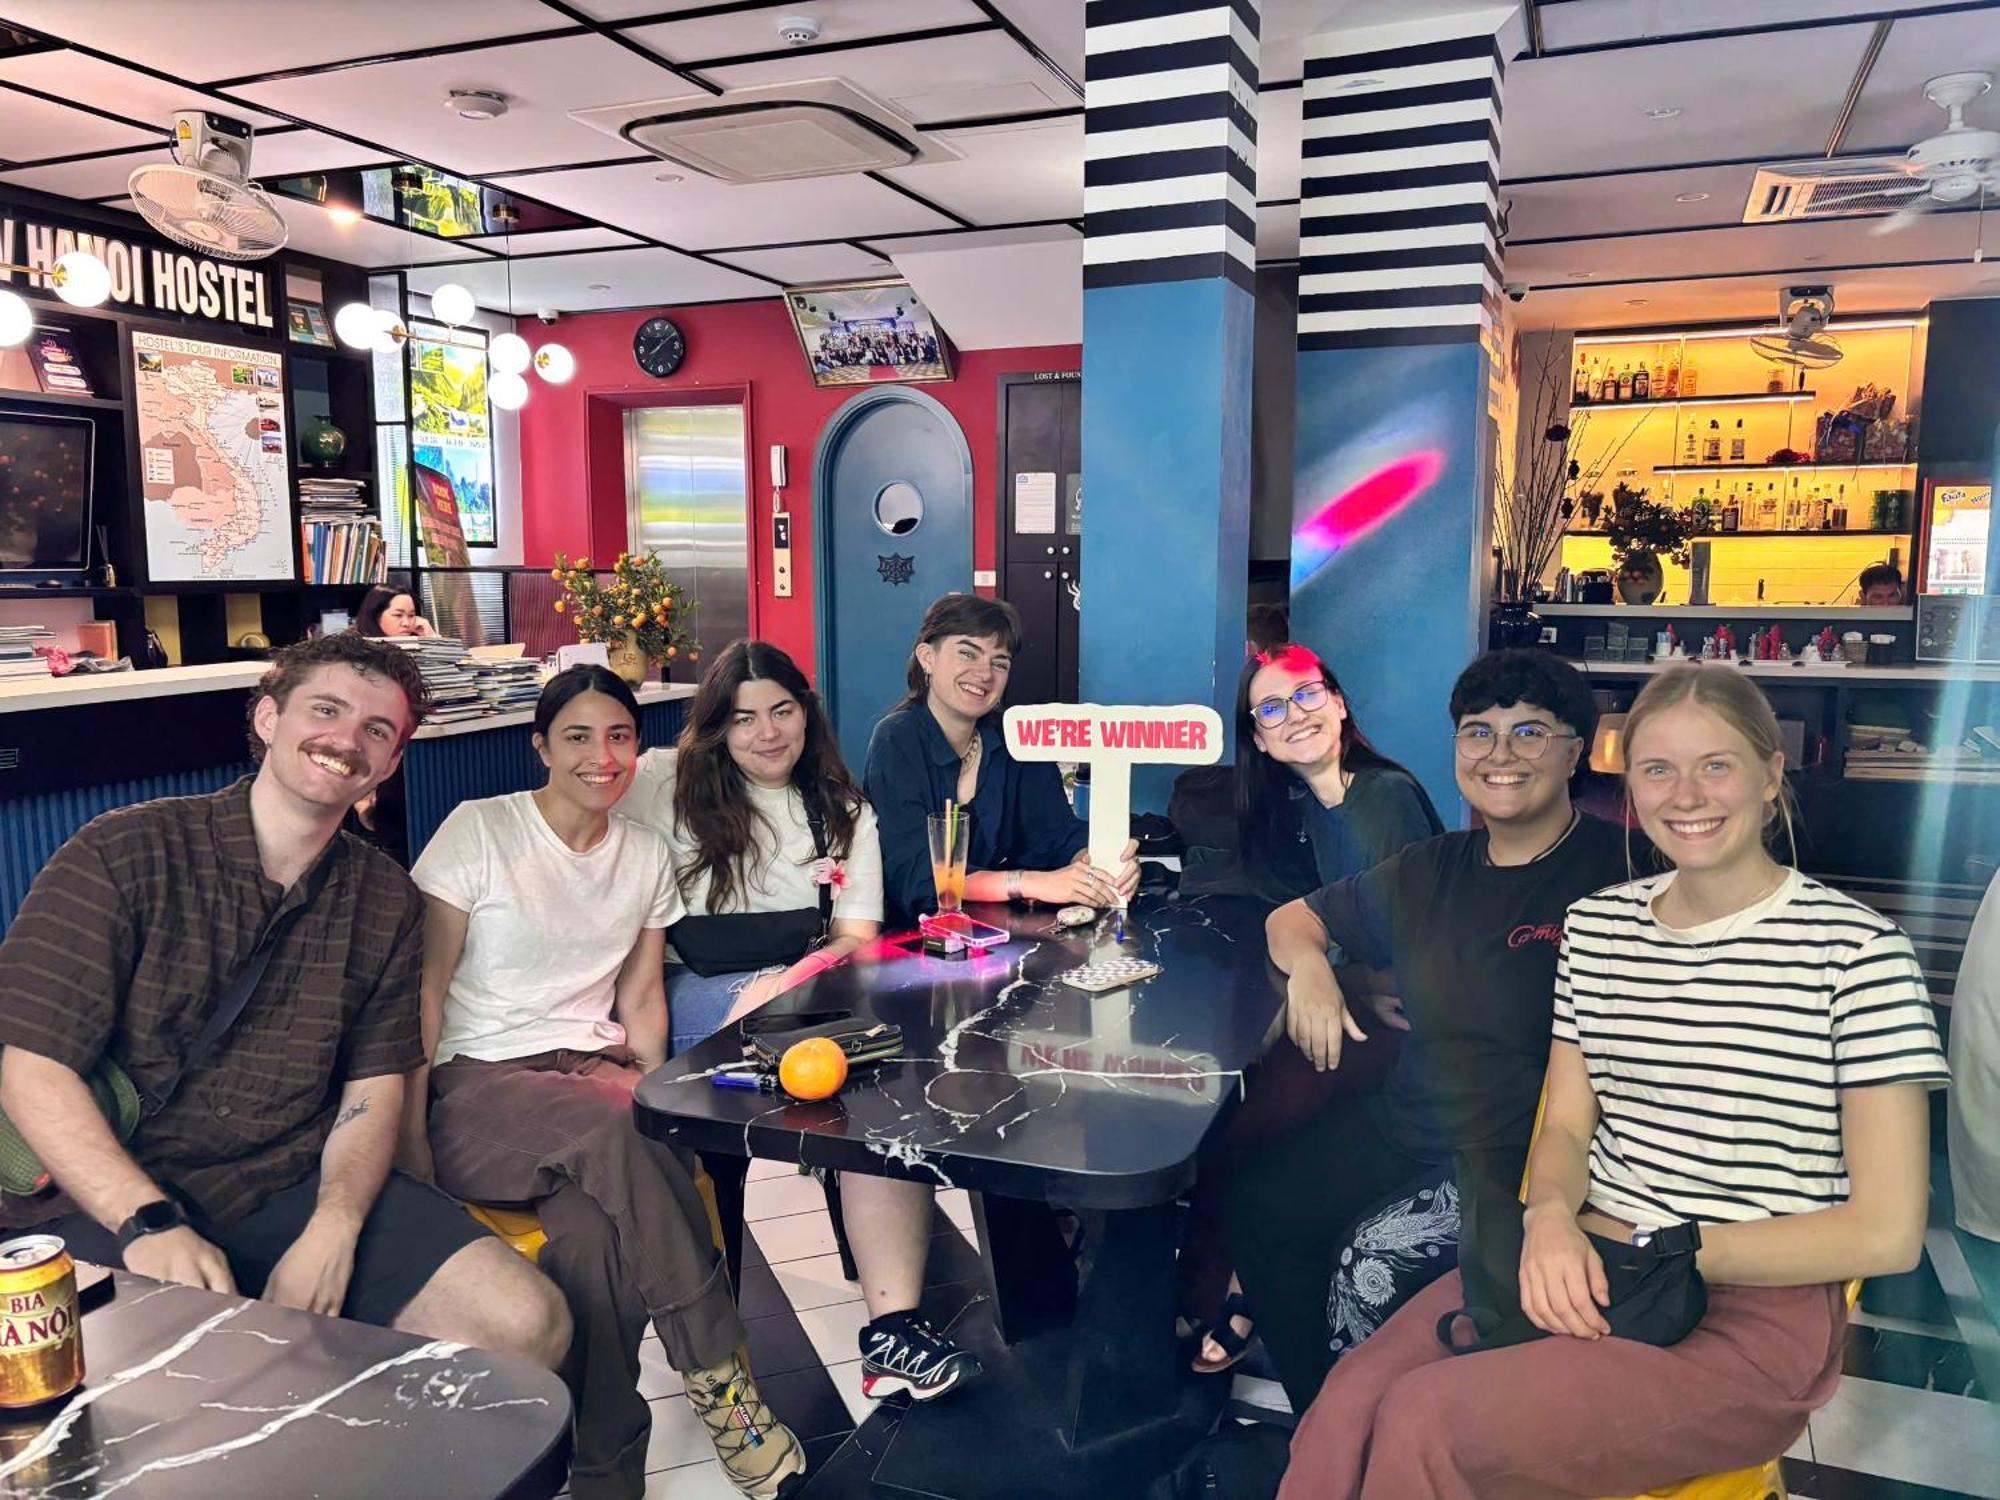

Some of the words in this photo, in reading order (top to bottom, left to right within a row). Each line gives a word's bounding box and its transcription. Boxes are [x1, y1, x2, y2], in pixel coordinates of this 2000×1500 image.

[152, 250, 273, 328] HOSTEL
[138, 335, 183, 353] HOSTEL'S
[185, 342, 211, 356] TOUR
[213, 346, 277, 365] INFORMATION
[1034, 372, 1053, 381] LOST
[1016, 718, 1092, 747] WE'RE
[1100, 720, 1208, 750] WINNER
[11, 1292, 46, 1314] BIA
[0, 1318, 22, 1346] À
[28, 1305, 74, 1344] NỘI
